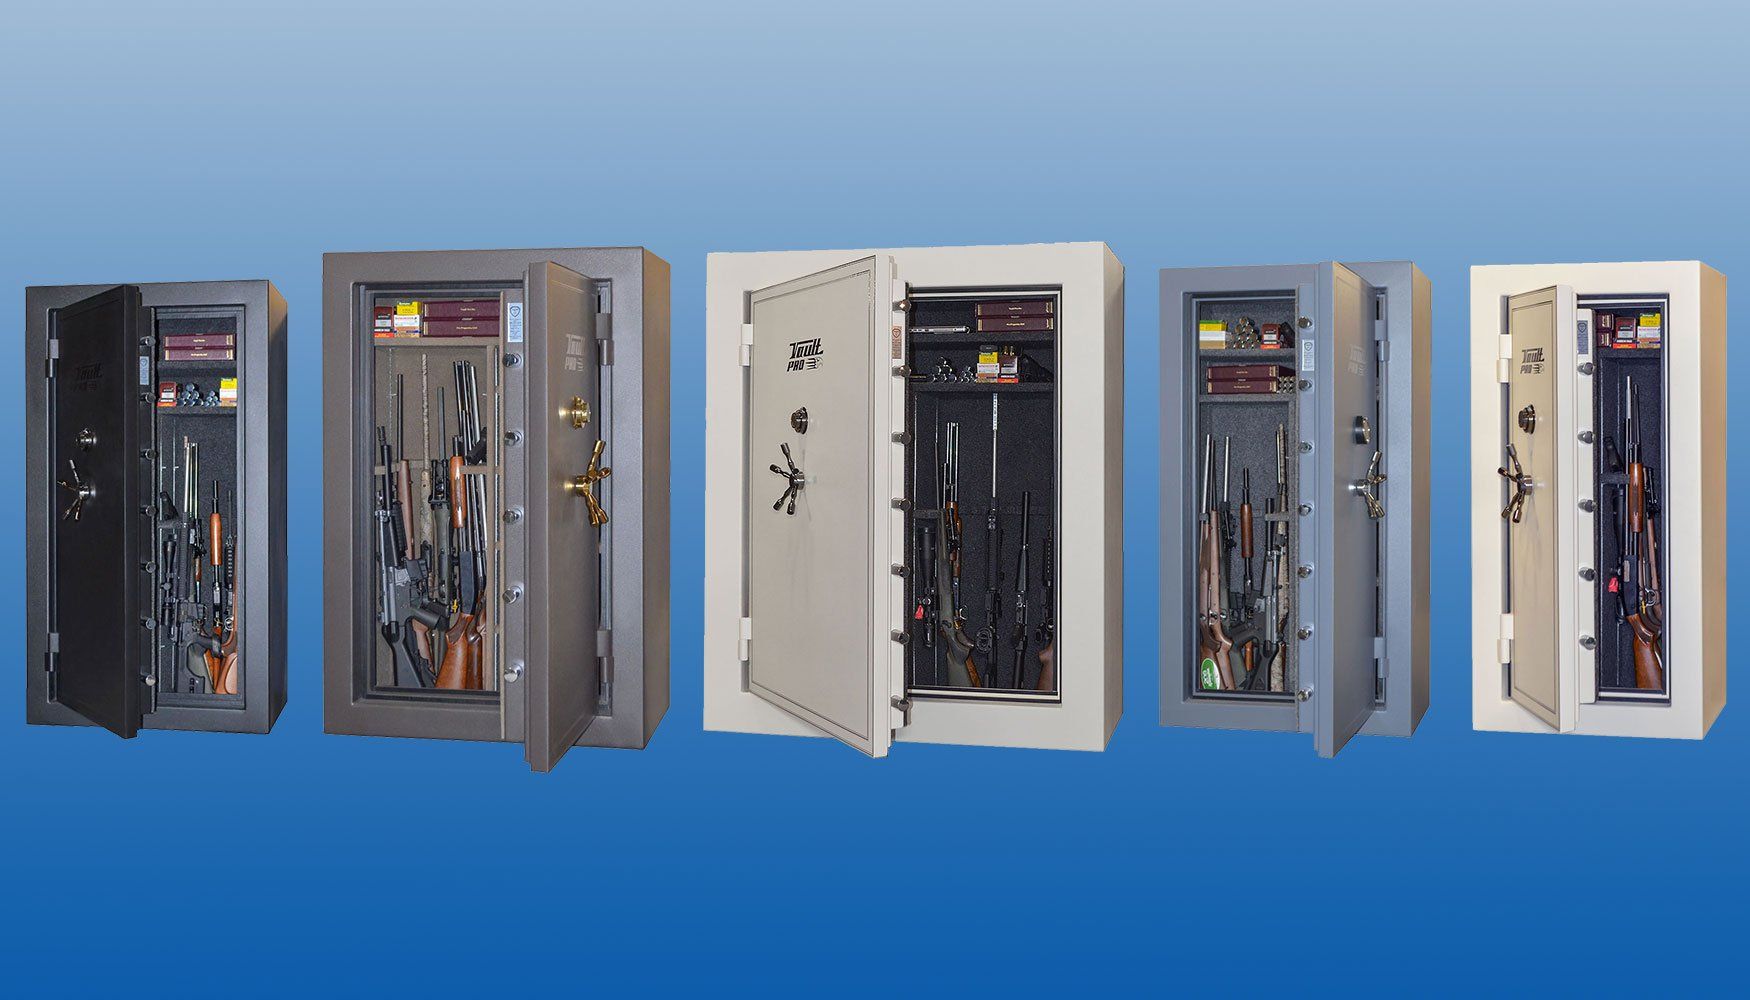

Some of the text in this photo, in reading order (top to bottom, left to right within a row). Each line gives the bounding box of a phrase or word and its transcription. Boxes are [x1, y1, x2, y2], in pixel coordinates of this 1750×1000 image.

[790, 338, 823, 359] Vault
[1521, 347, 1544, 364] Vault
[787, 360, 804, 372] PRO
